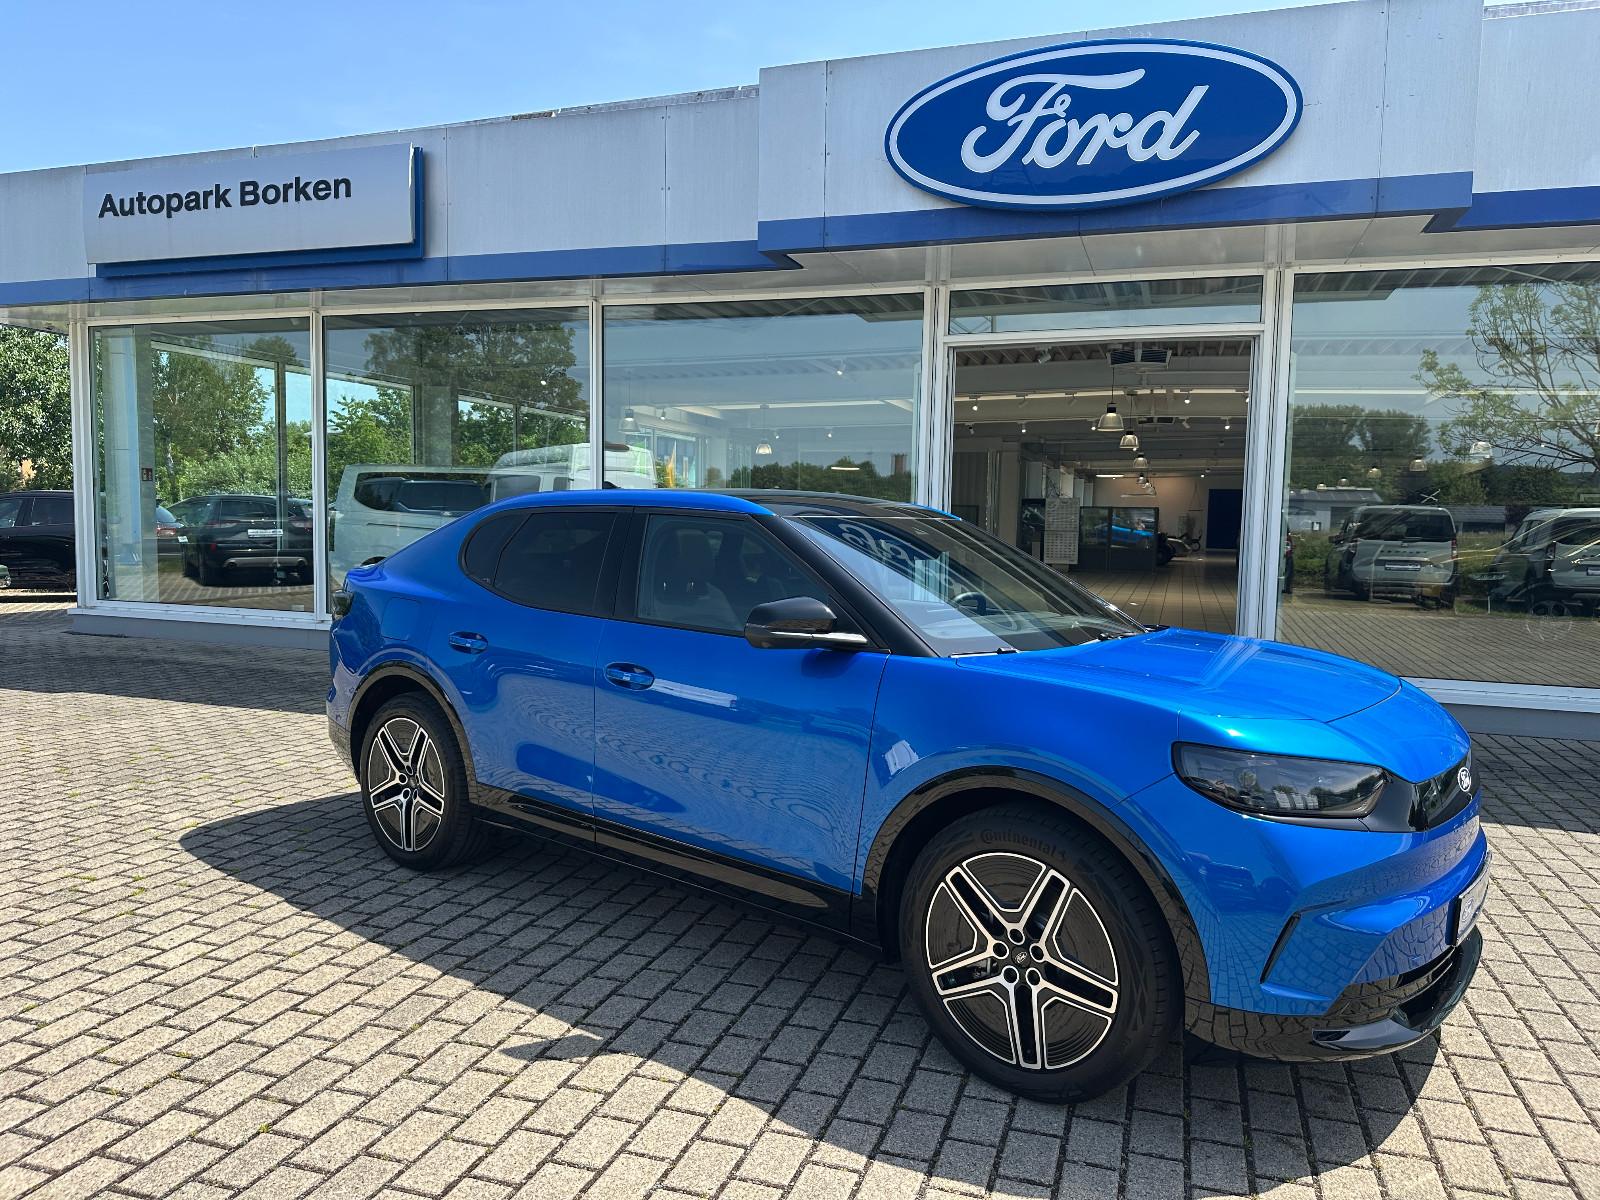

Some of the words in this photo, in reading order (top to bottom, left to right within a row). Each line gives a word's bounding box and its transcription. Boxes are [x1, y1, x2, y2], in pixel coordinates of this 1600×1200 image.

[961, 69, 1209, 173] Ford
[98, 183, 232, 218] Autopark
[240, 176, 352, 206] Borken
